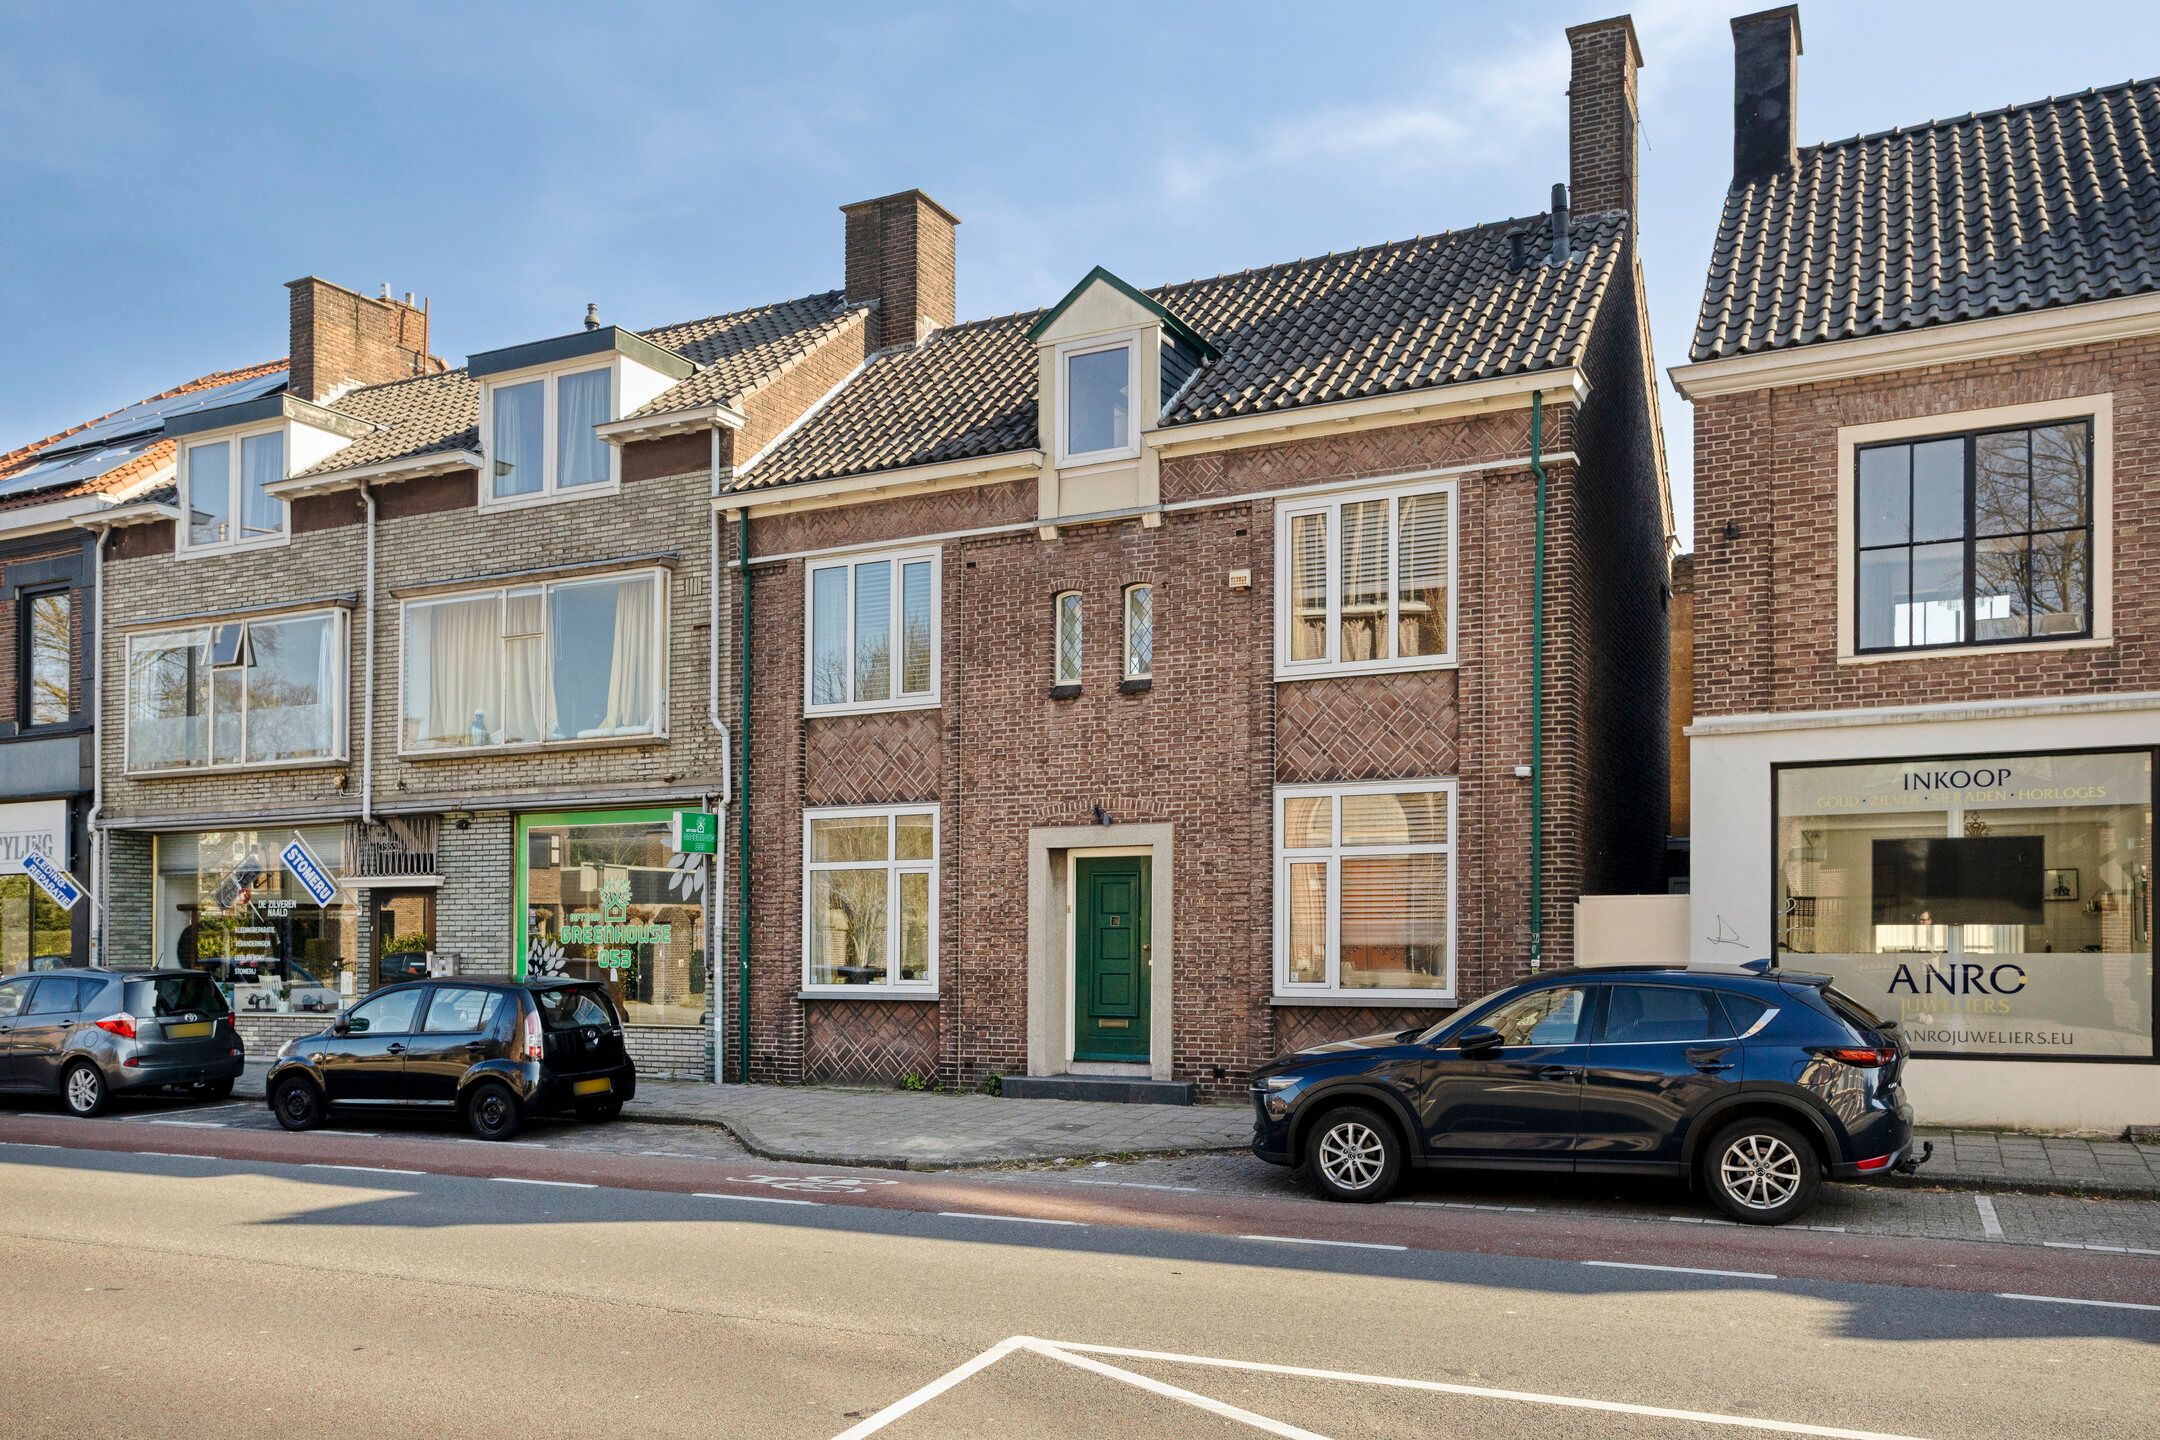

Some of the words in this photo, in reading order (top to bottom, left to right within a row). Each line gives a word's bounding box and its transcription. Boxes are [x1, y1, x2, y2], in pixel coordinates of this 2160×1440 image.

[1903, 769, 2012, 790] INKOOP
[1817, 796, 1859, 808] GOUD
[1870, 794, 1919, 806] ZILVER
[1932, 790, 2006, 805] SIERADEN
[2019, 785, 2106, 801] HORLOGES
[0, 834, 53, 859] YLING
[30, 851, 67, 889] KLEDING-
[28, 864, 71, 906] REPARATIE
[258, 900, 266, 908] DE
[268, 900, 296, 908] ZILVEREN
[268, 908, 288, 917] NAALD
[561, 924, 671, 944] GREENHOUSE
[598, 949, 631, 968] 053
[1887, 963, 2028, 995] ANRO
[1901, 998, 2010, 1021] JUWELIERS
[1903, 1030, 2073, 1045] ANROJUWELIERS.EU
